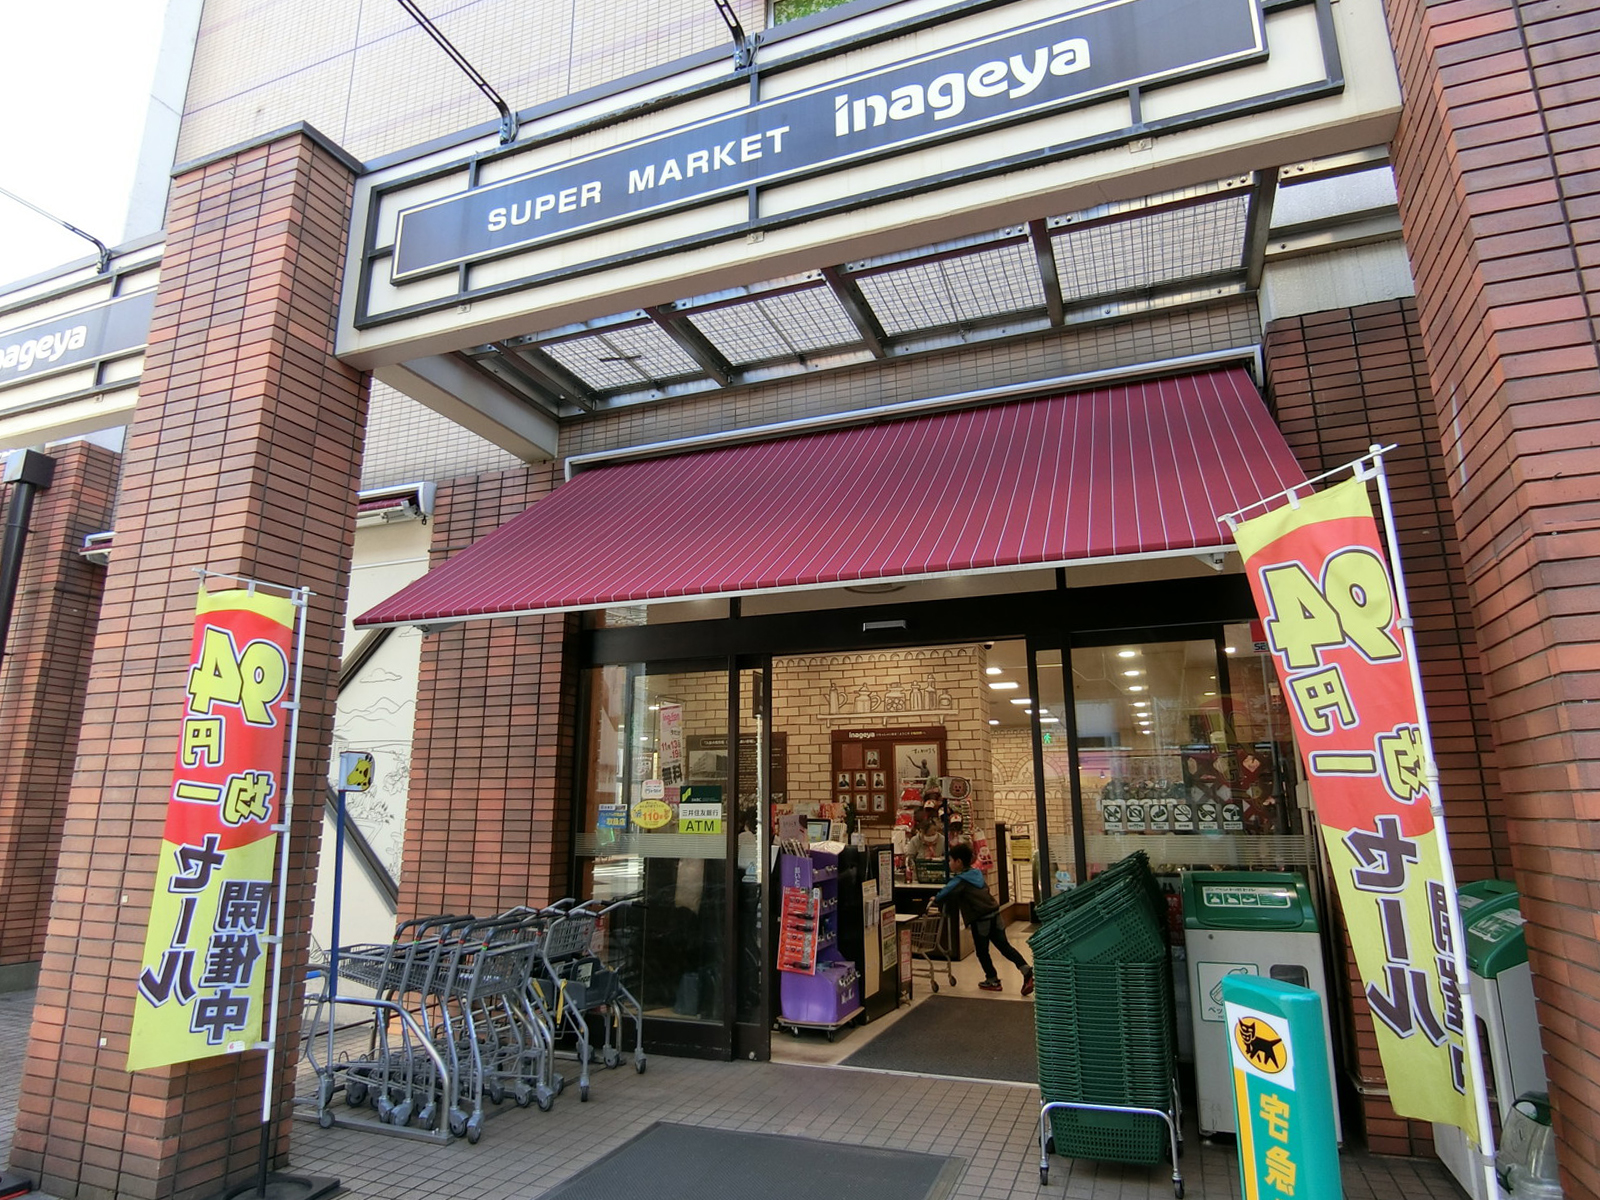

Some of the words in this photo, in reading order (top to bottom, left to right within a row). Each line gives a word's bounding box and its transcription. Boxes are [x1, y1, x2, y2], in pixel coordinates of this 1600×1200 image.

[487, 180, 603, 233] SUPER
[627, 126, 792, 194] MARKET
[835, 36, 1092, 137] inageya
[682, 808, 719, 818] 三井住友銀行
[685, 819, 715, 833] ATM
[1259, 1093, 1299, 1200] 宅急
